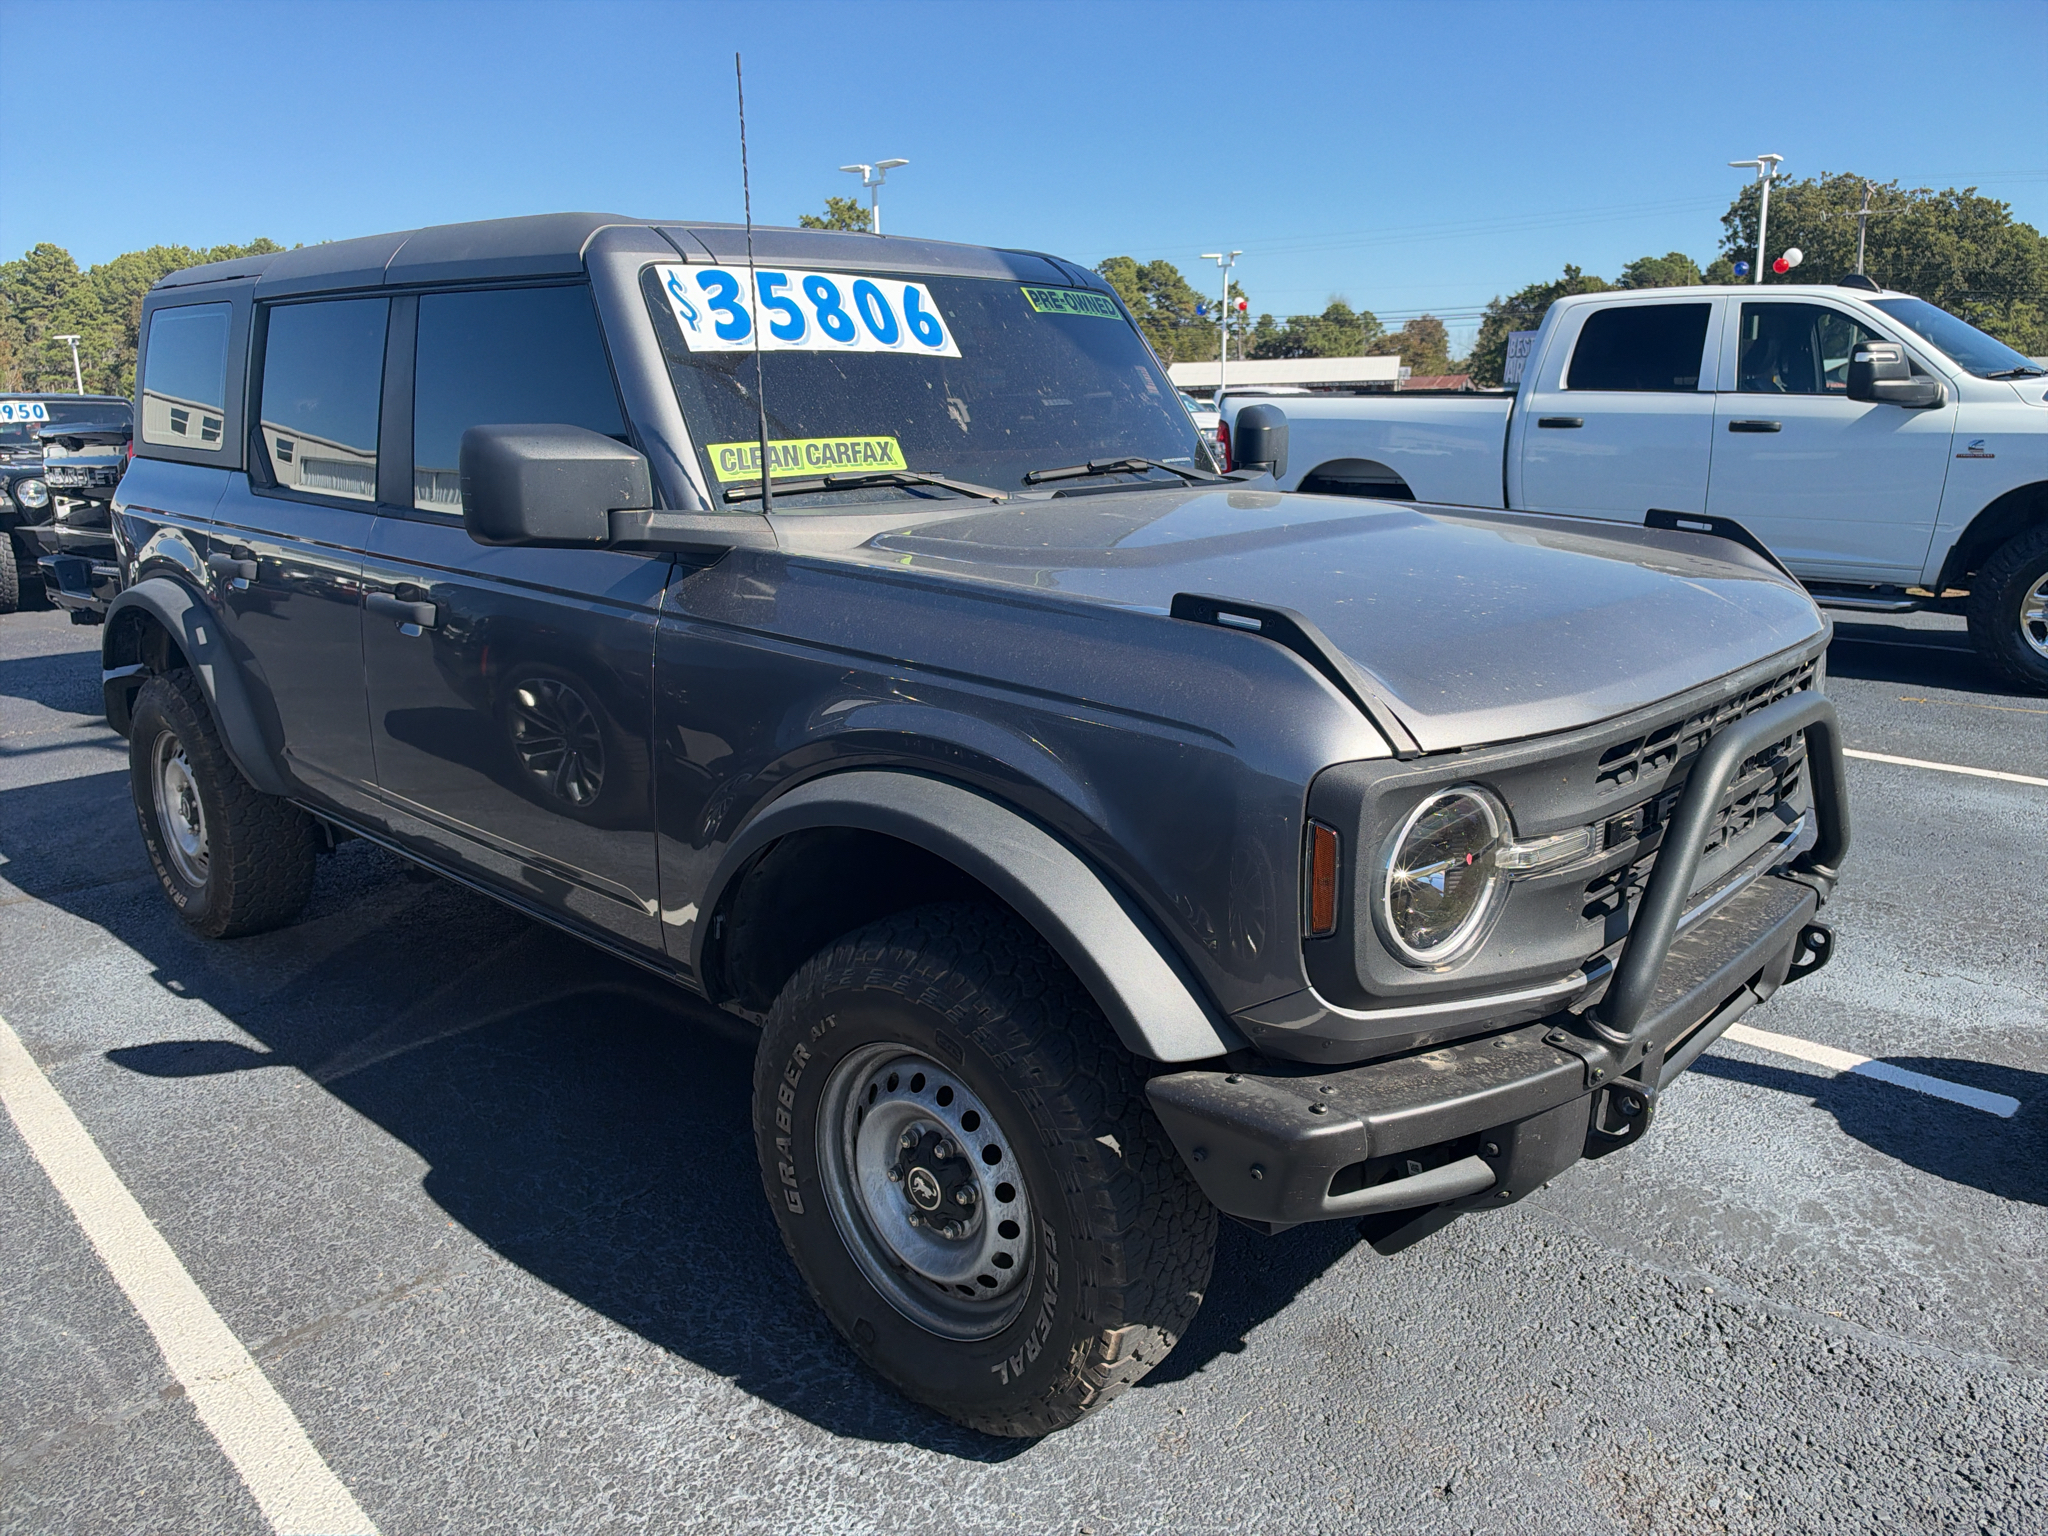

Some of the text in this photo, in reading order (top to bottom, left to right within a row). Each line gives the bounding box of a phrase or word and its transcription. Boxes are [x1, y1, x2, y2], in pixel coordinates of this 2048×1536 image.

[667, 269, 944, 347] $35806
[1026, 289, 1117, 316] PRE-OWNED
[720, 441, 893, 472] CLEAN CARFAX
[776, 1014, 838, 1215] GRABBER A/T
[991, 1219, 1059, 1386] GENERAL
